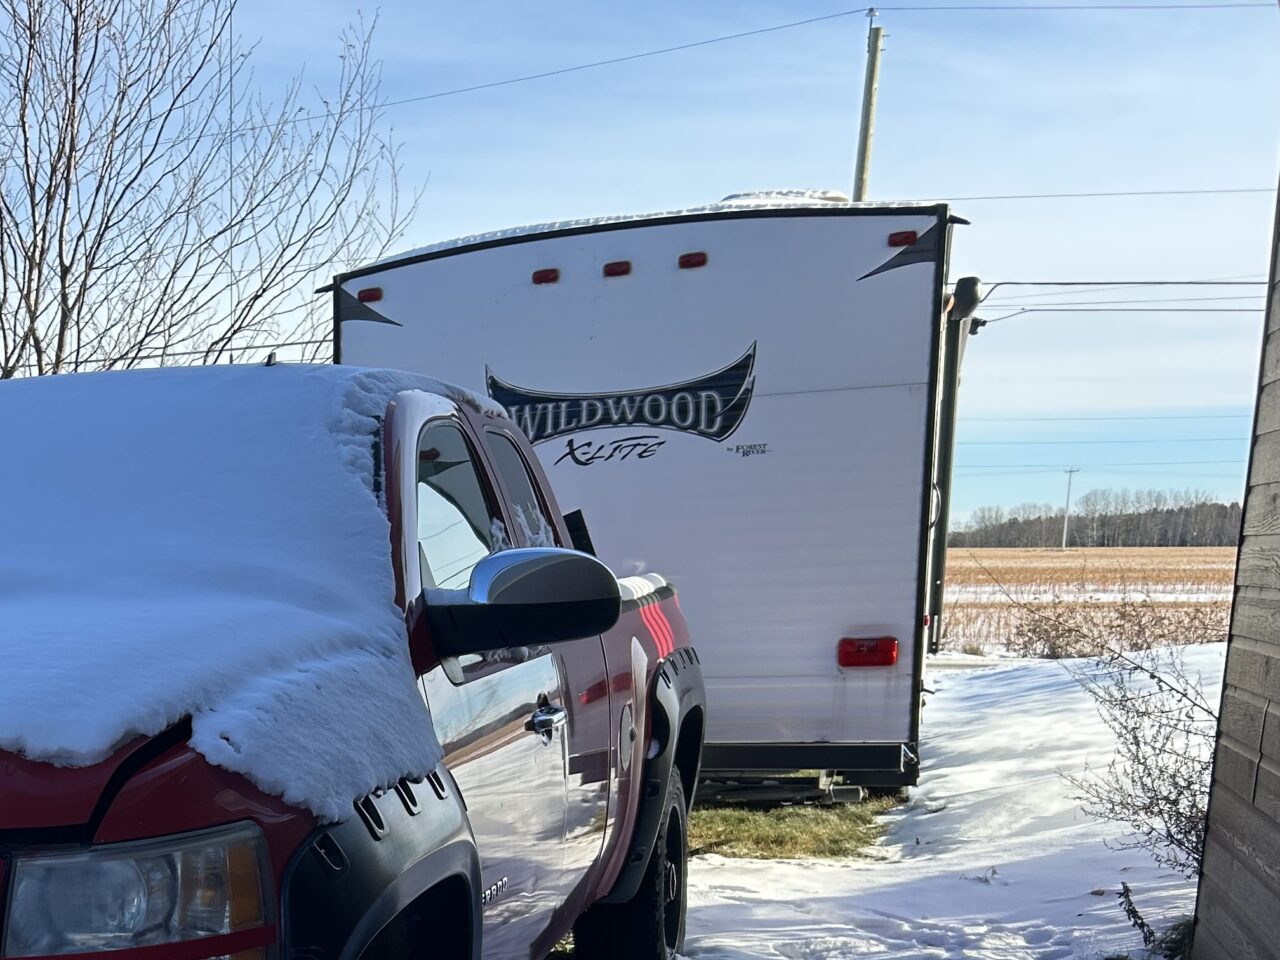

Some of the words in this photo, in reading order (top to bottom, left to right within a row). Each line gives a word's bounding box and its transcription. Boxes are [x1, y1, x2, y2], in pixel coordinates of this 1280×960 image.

[508, 392, 723, 441] WILDWOOD
[554, 436, 666, 466] X-LITE
[735, 443, 768, 454] FOREST
